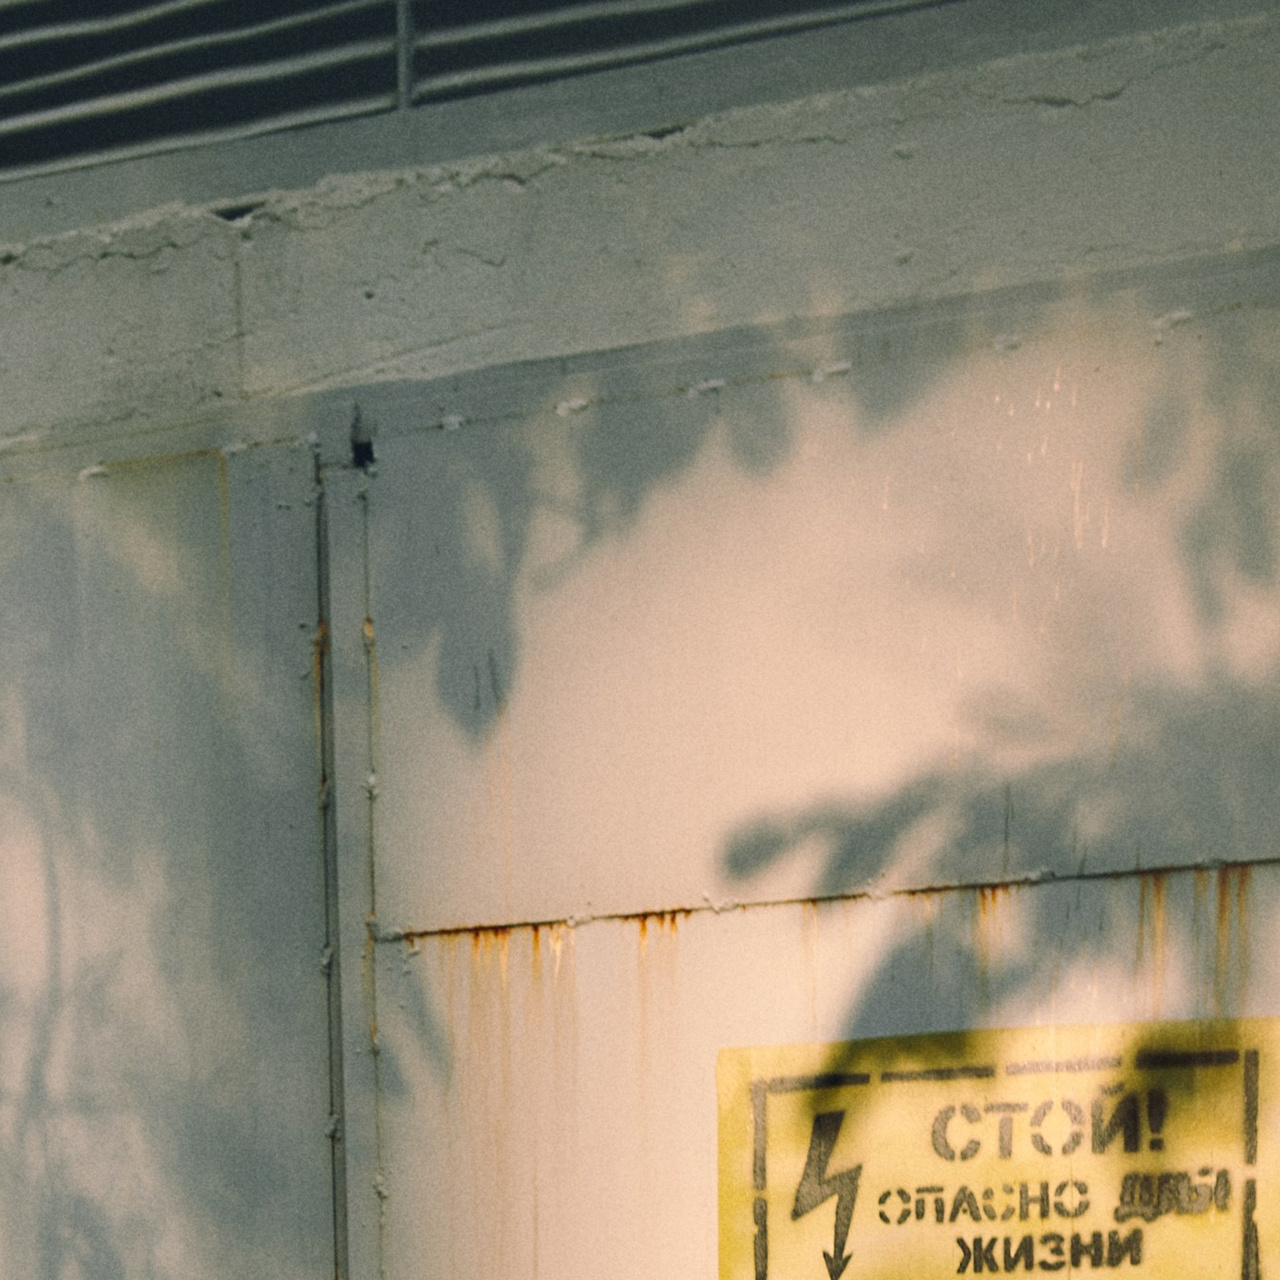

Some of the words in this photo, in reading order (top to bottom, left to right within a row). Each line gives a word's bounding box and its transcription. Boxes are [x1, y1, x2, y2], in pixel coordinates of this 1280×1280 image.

[931, 1082, 1169, 1161] СТОЙ!
[877, 1180, 1090, 1226] ОПАСНО
[956, 1228, 1144, 1274] ЖИЗНИ
